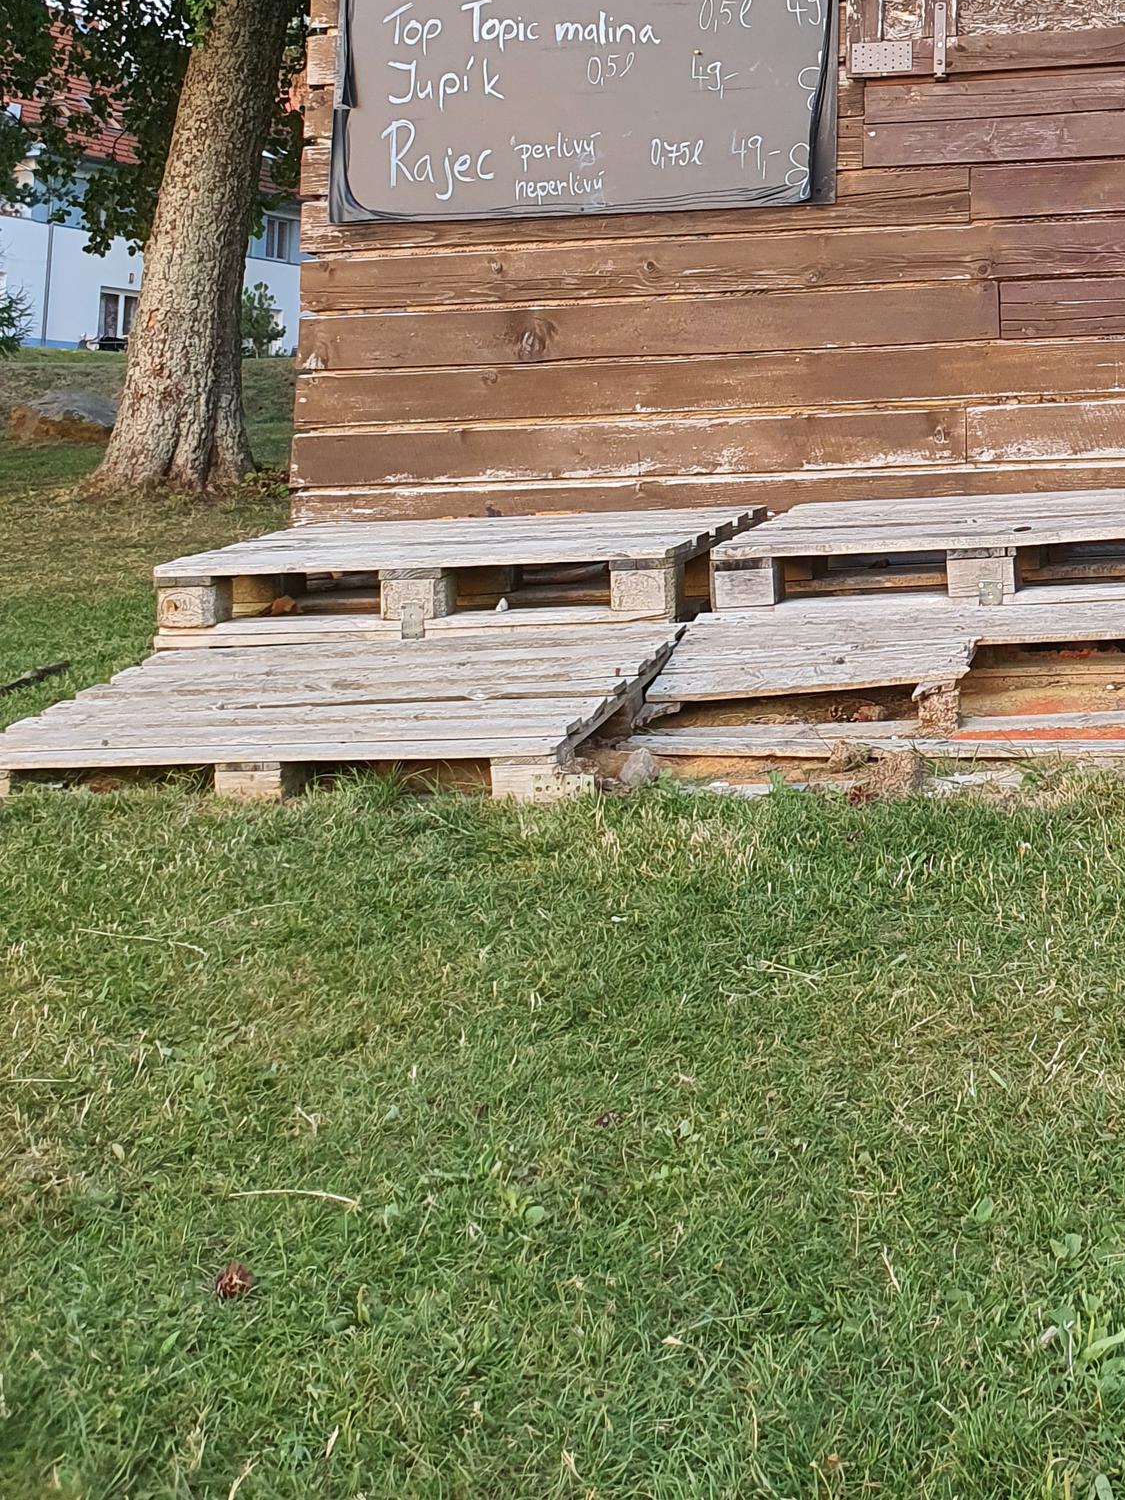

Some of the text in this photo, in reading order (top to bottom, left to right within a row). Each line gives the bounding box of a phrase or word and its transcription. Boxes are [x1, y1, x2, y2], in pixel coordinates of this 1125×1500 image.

[383, 1, 442, 56] Top
[555, 10, 661, 45] malina
[386, 55, 505, 113] Jupík
[381, 118, 495, 201] Rajec
